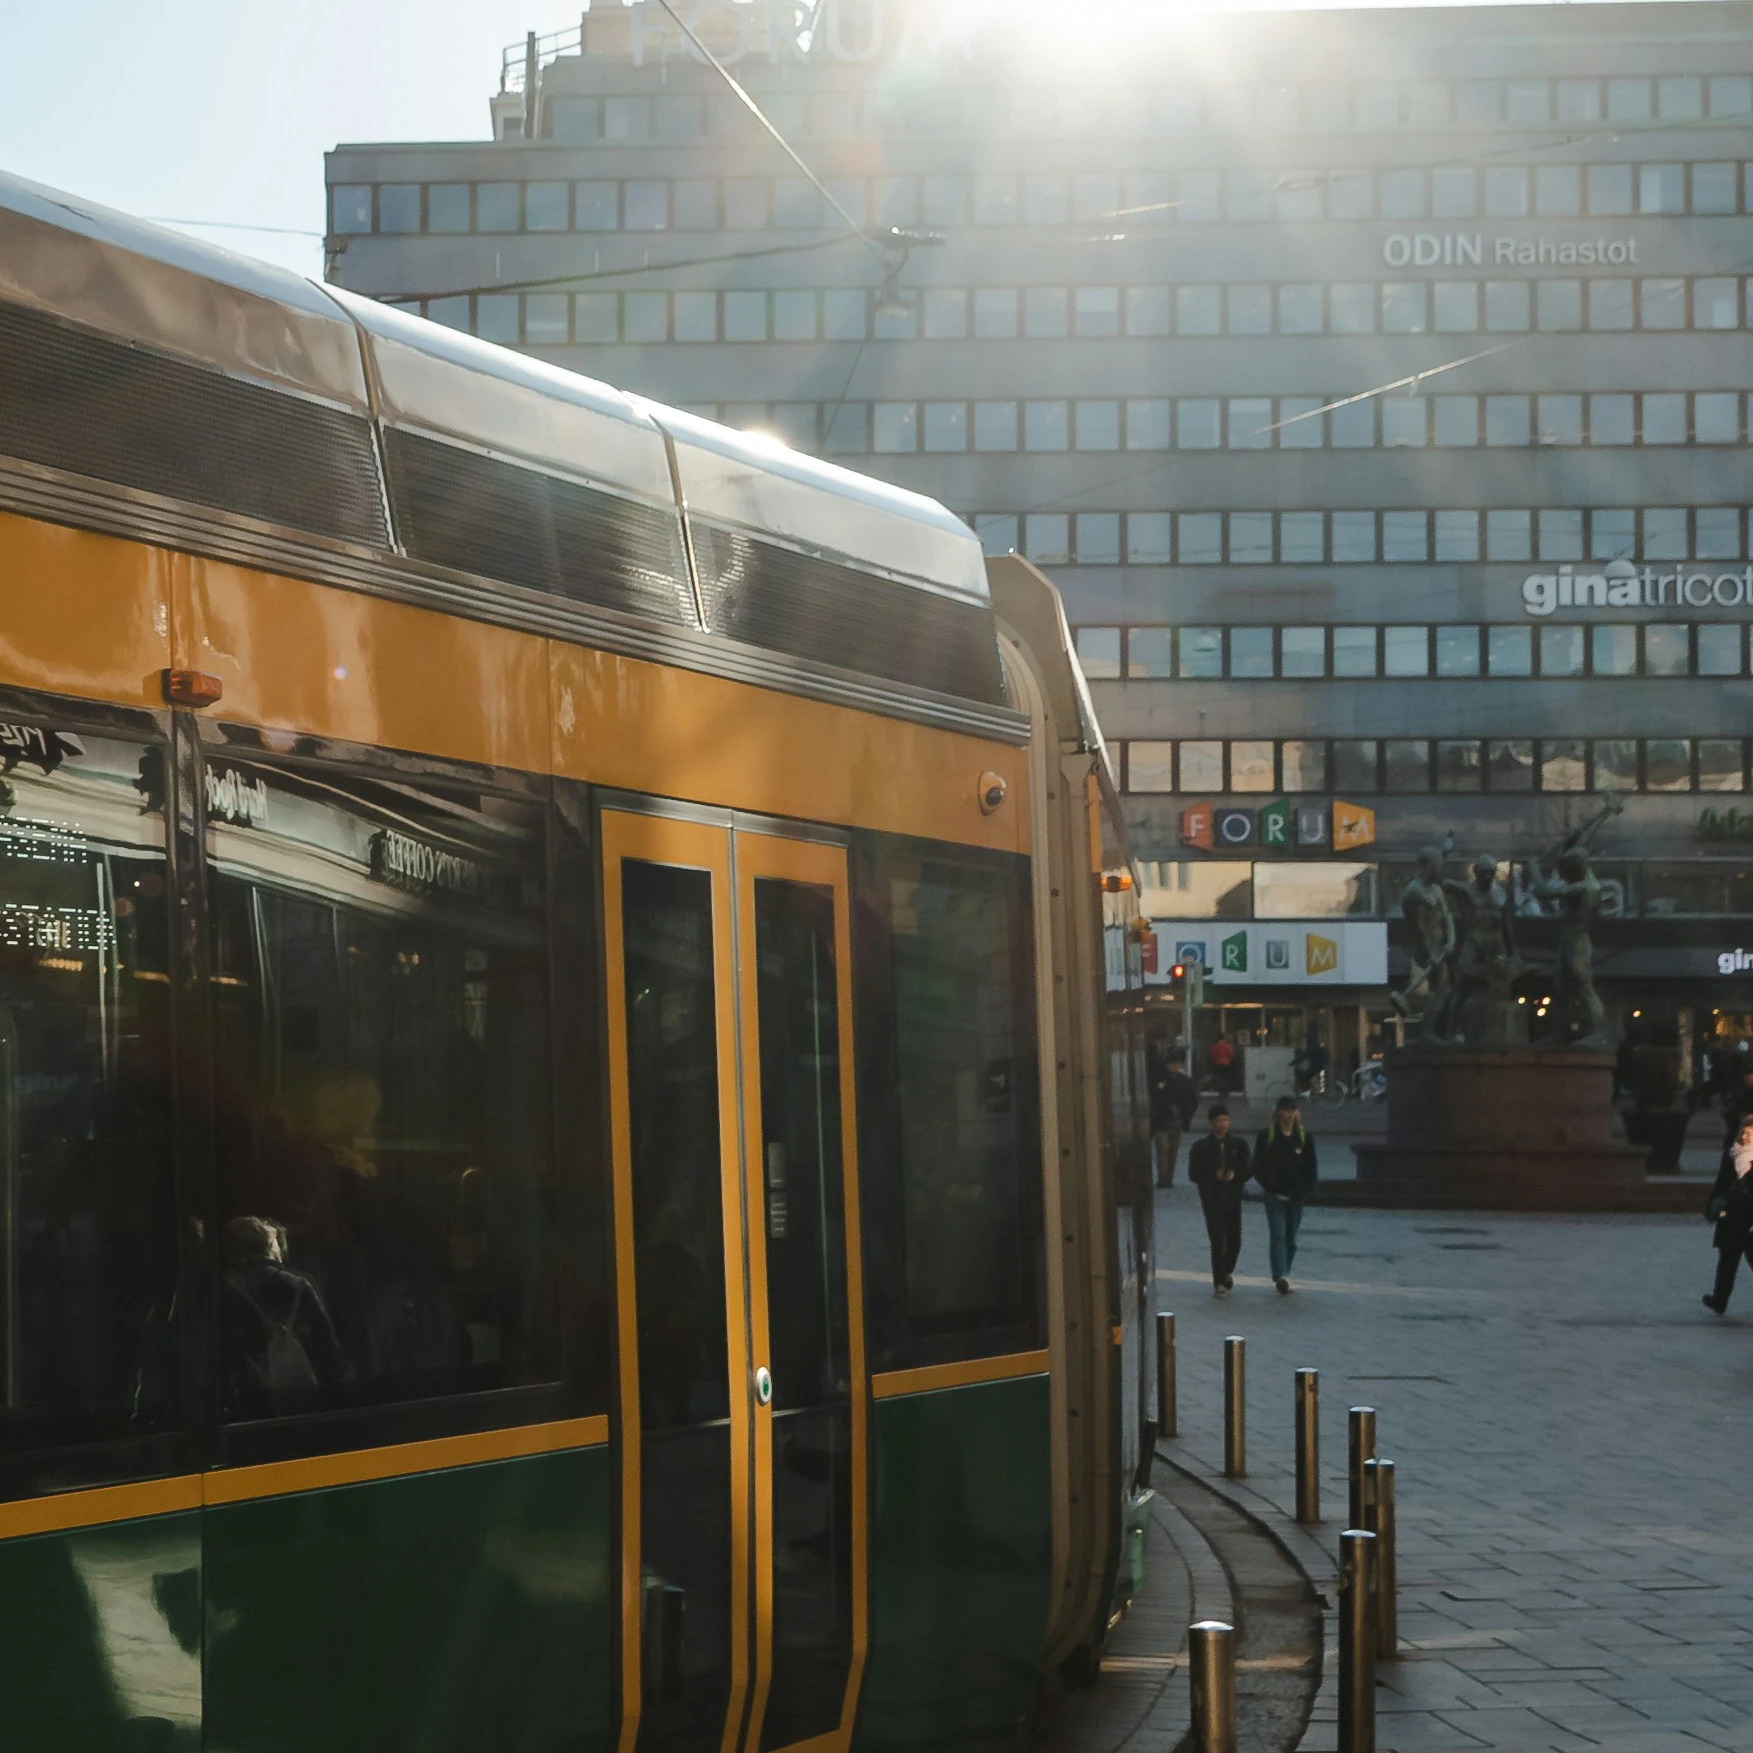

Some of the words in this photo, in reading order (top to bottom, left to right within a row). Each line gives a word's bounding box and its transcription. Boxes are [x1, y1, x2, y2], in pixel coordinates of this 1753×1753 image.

[1383, 233, 1482, 267] ODIN
[1494, 236, 1639, 266] Rahastot
[1189, 810, 1370, 845] FORUM
